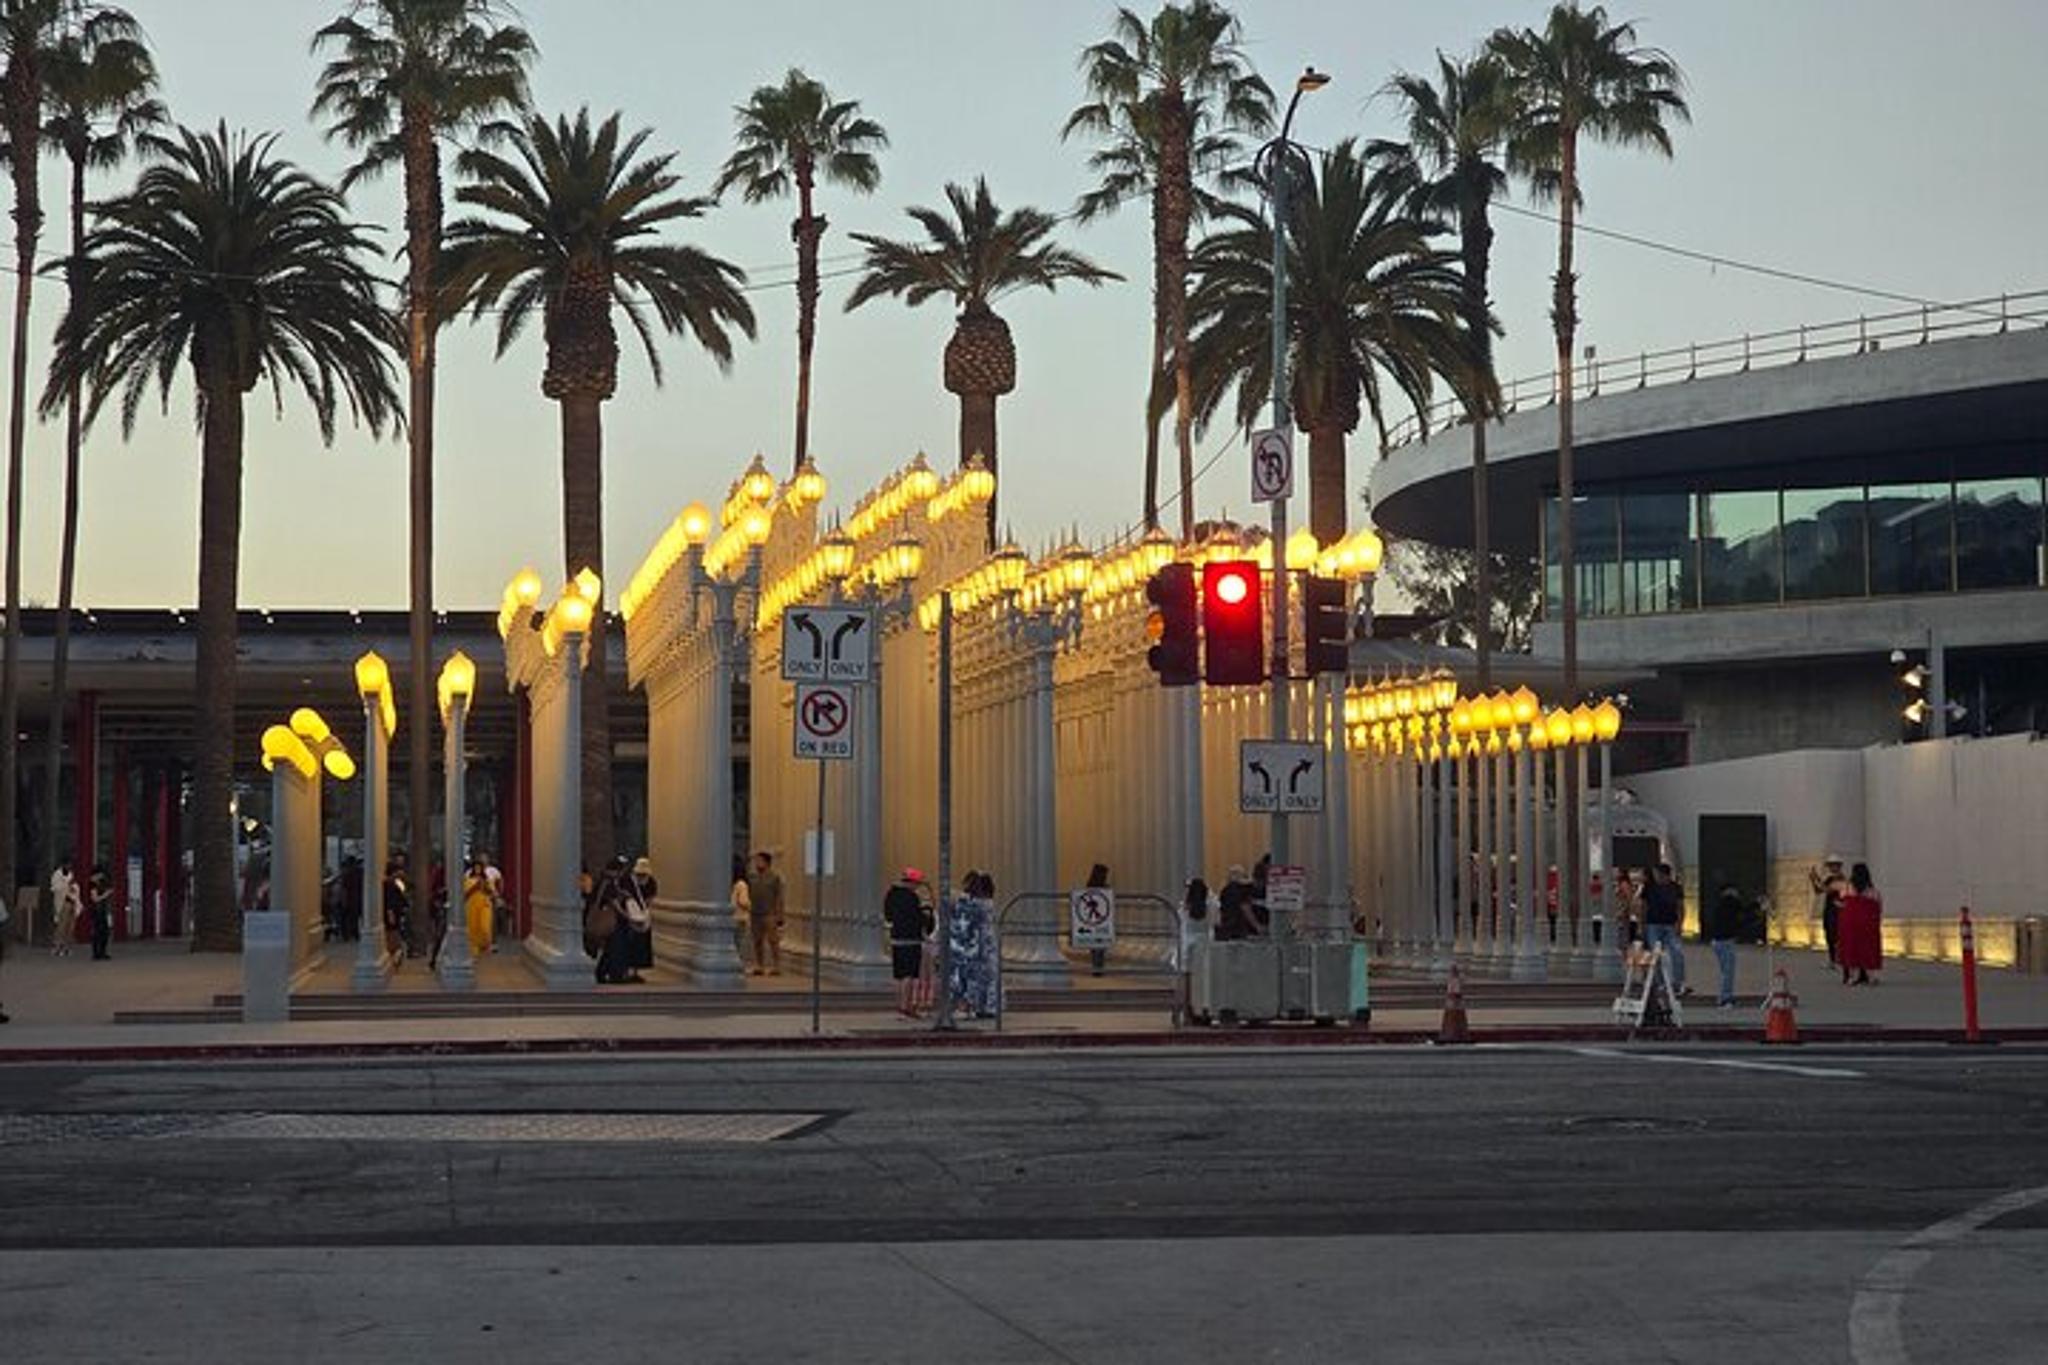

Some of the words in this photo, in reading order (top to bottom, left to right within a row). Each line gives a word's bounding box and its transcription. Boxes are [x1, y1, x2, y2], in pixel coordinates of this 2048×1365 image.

[788, 661, 821, 673] ONLY
[831, 661, 864, 675] ONLY
[799, 742, 817, 753] ON
[823, 742, 848, 754] RED
[1286, 795, 1319, 808] ONLY
